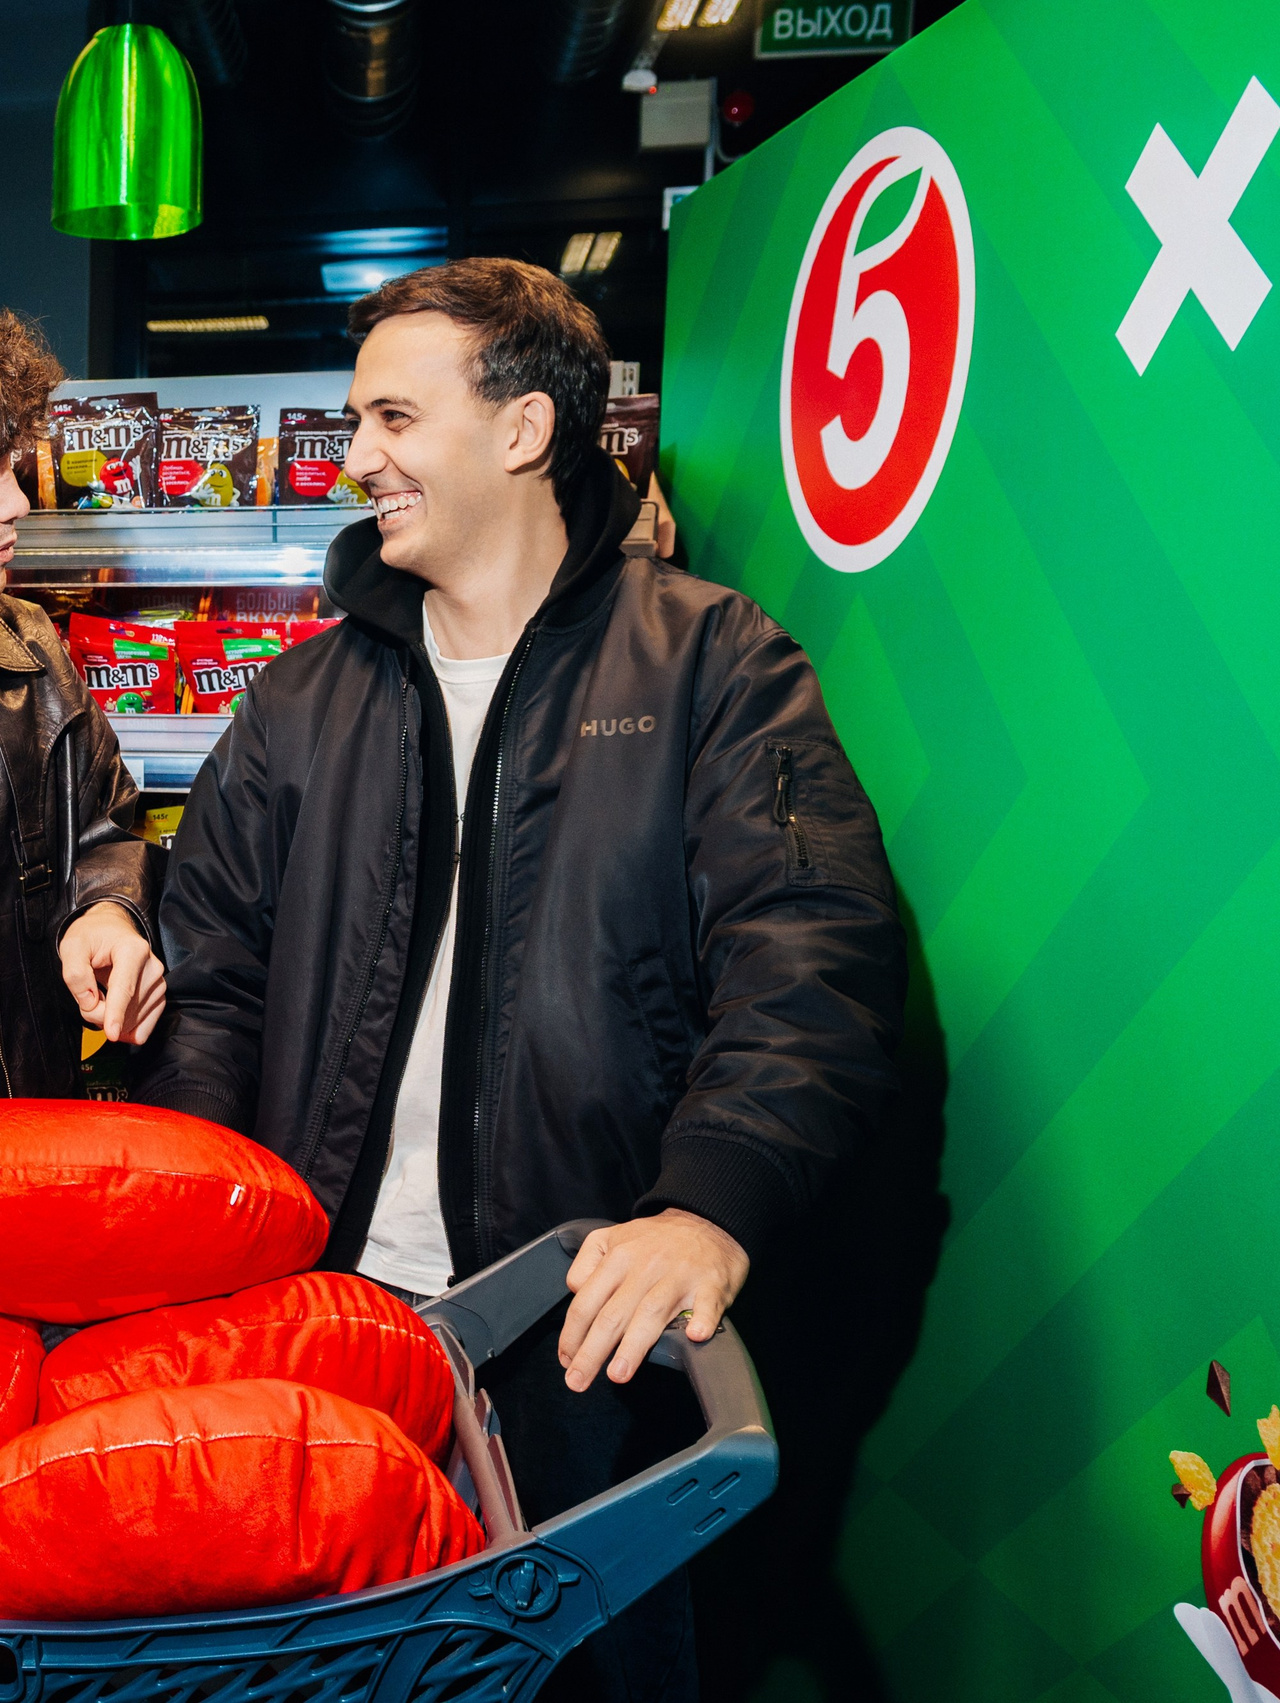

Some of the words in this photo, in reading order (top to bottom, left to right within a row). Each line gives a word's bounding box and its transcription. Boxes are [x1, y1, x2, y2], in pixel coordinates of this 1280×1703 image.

[774, 4, 893, 41] ВЫХОД
[236, 592, 300, 611] БОЛЬШЕ
[580, 714, 657, 738] HUGO
